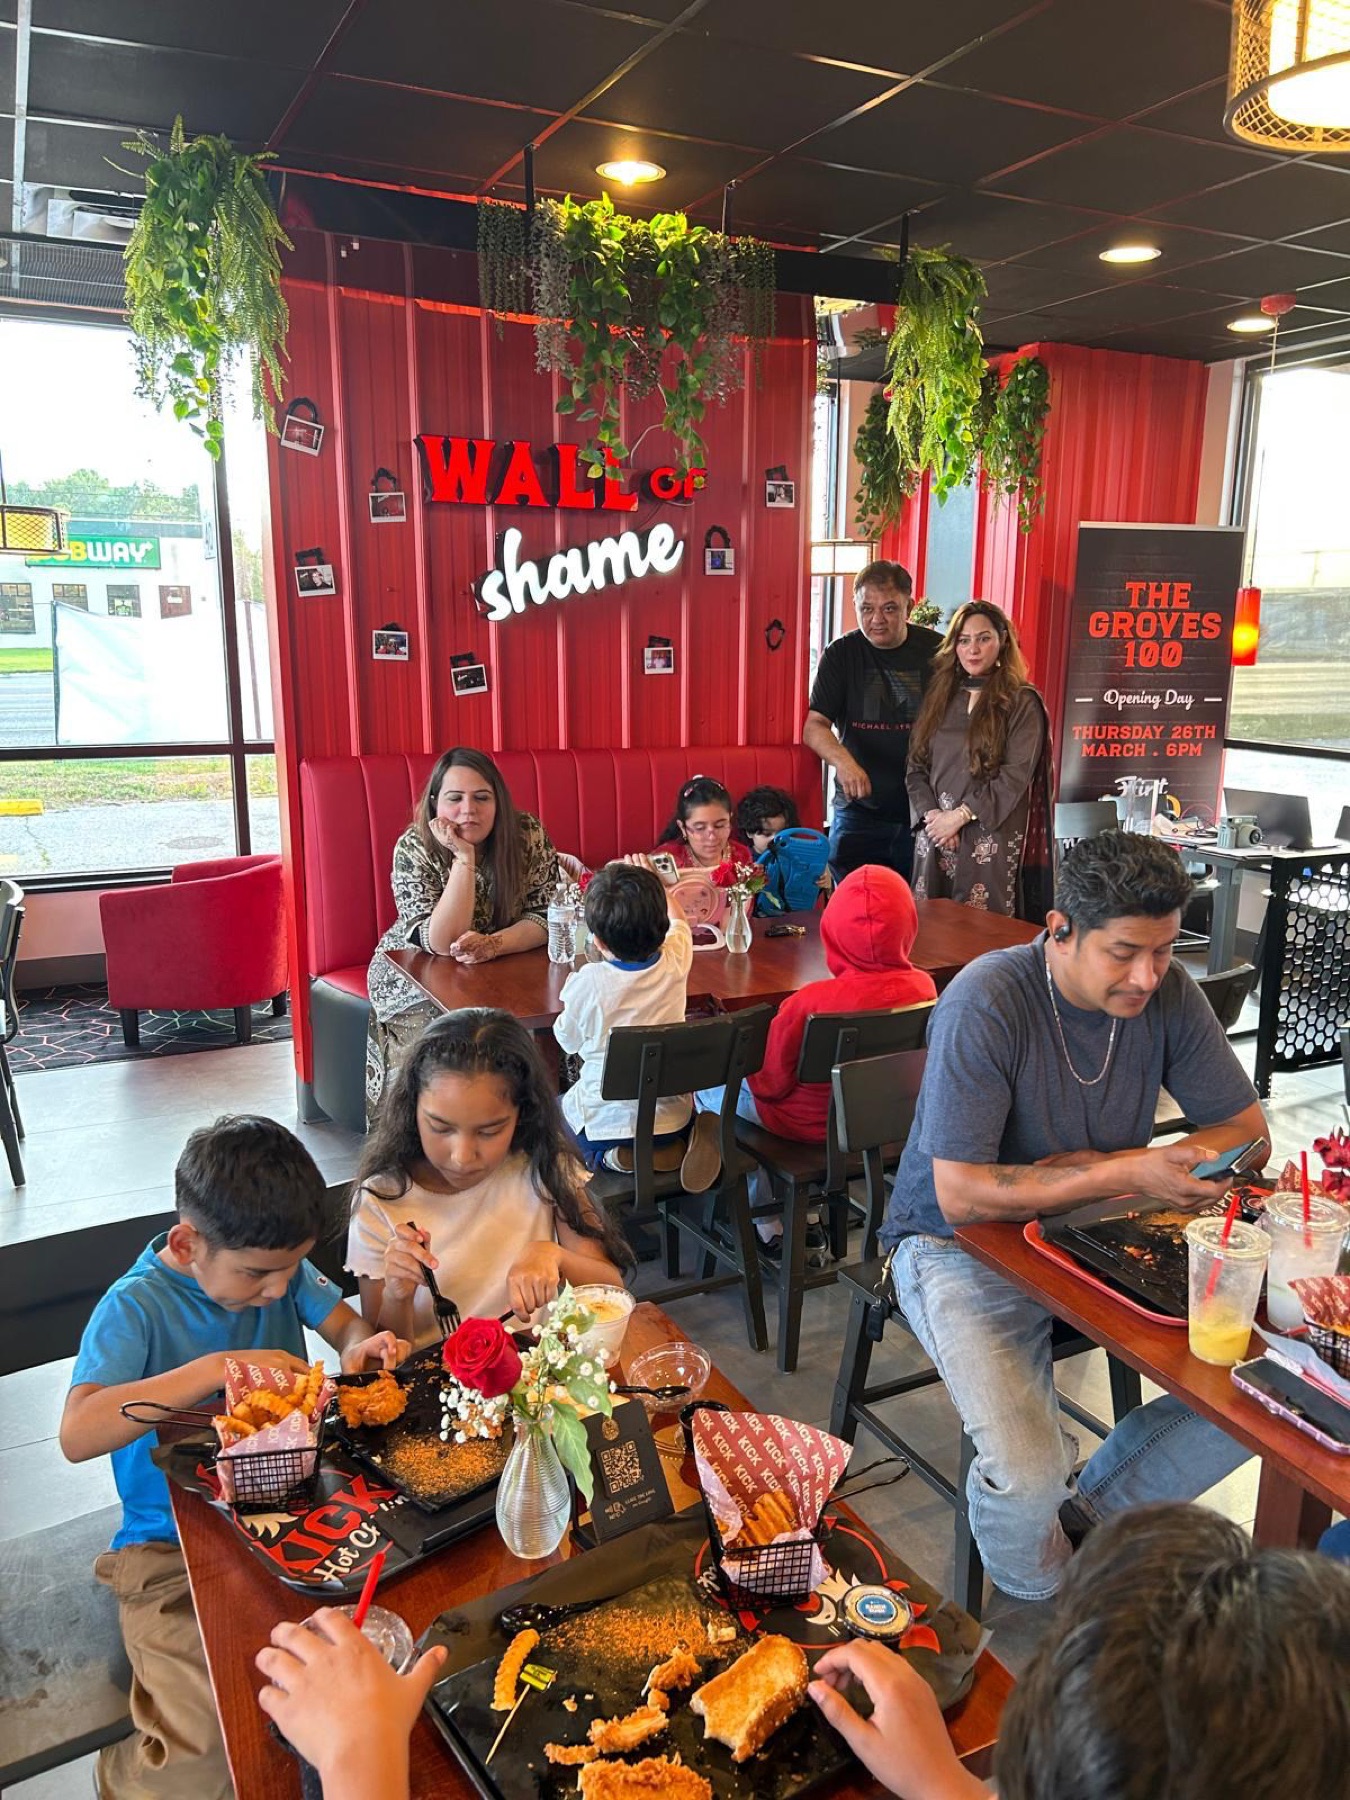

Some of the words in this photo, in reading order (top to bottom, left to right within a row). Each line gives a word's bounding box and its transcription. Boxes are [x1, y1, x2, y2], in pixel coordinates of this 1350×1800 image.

[416, 434, 639, 511] WALL
[650, 466, 707, 499] OF
[27, 540, 154, 564] BWAY
[481, 522, 684, 621] shame
[1125, 581, 1192, 610] THE
[1088, 611, 1223, 639] GROVES
[1124, 640, 1183, 668] 100
[1103, 689, 1161, 711] Opening
[1164, 689, 1196, 711] Day
[852, 721, 891, 730] MICHAEL
[1072, 724, 1165, 740] THURSDAY
[1171, 724, 1217, 739] 26TH
[1081, 743, 1147, 757] MARCH
[1165, 743, 1203, 757] 6PM
[1114, 776, 1169, 797] Firt
[698, 1409, 714, 1431] ICK
[712, 1431, 736, 1462] KICK
[738, 1435, 763, 1466] KICK
[762, 1437, 787, 1468] KICK
[789, 1445, 810, 1476] KICK
[733, 1464, 758, 1493] KICK
[811, 1452, 825, 1483] KICK
[267, 1474, 398, 1573] KICK
[313, 1547, 360, 1582] Hot
